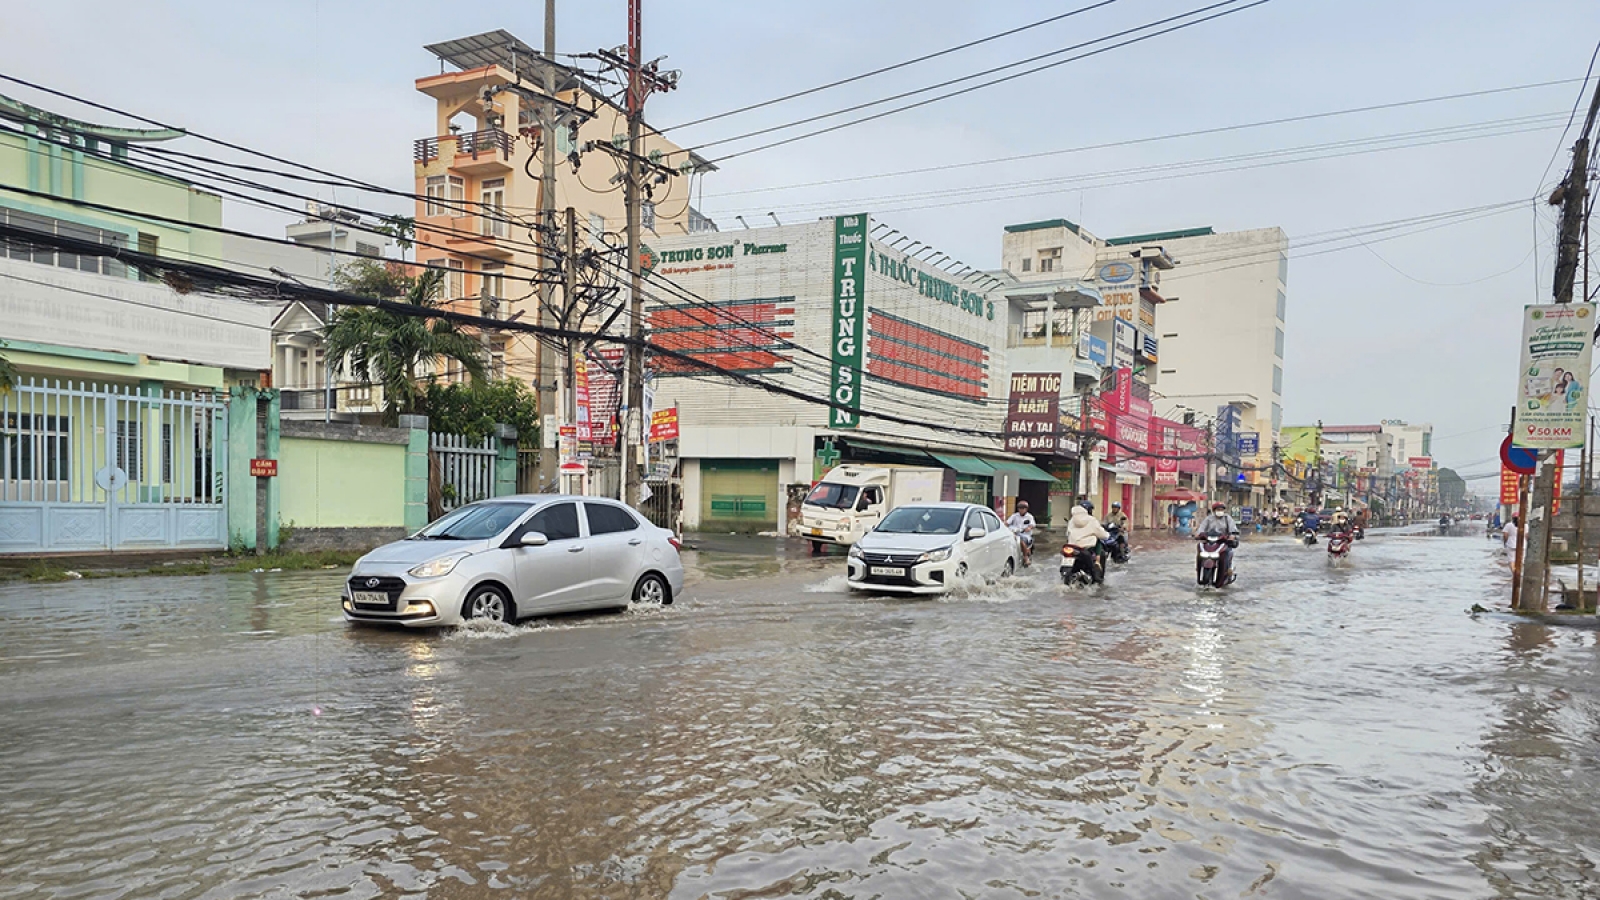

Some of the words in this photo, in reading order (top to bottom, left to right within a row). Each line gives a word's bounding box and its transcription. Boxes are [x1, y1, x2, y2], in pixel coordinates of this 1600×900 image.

[839, 231, 862, 245] Thuốc
[660, 248, 704, 263] TRUNG
[879, 253, 917, 287] THUỐC
[917, 270, 959, 307] TRUNG
[987, 301, 994, 321] 3
[837, 257, 857, 357] TRUNG
[1012, 374, 1037, 395] TIỆM
[1040, 374, 1060, 392] TÓC
[1018, 399, 1049, 413] NAM
[1011, 420, 1033, 432] RÁY
[1037, 422, 1053, 433] TAI
[1537, 427, 1551, 436] 50
[1553, 427, 1572, 436] KM
[1008, 436, 1027, 449] GỘI
